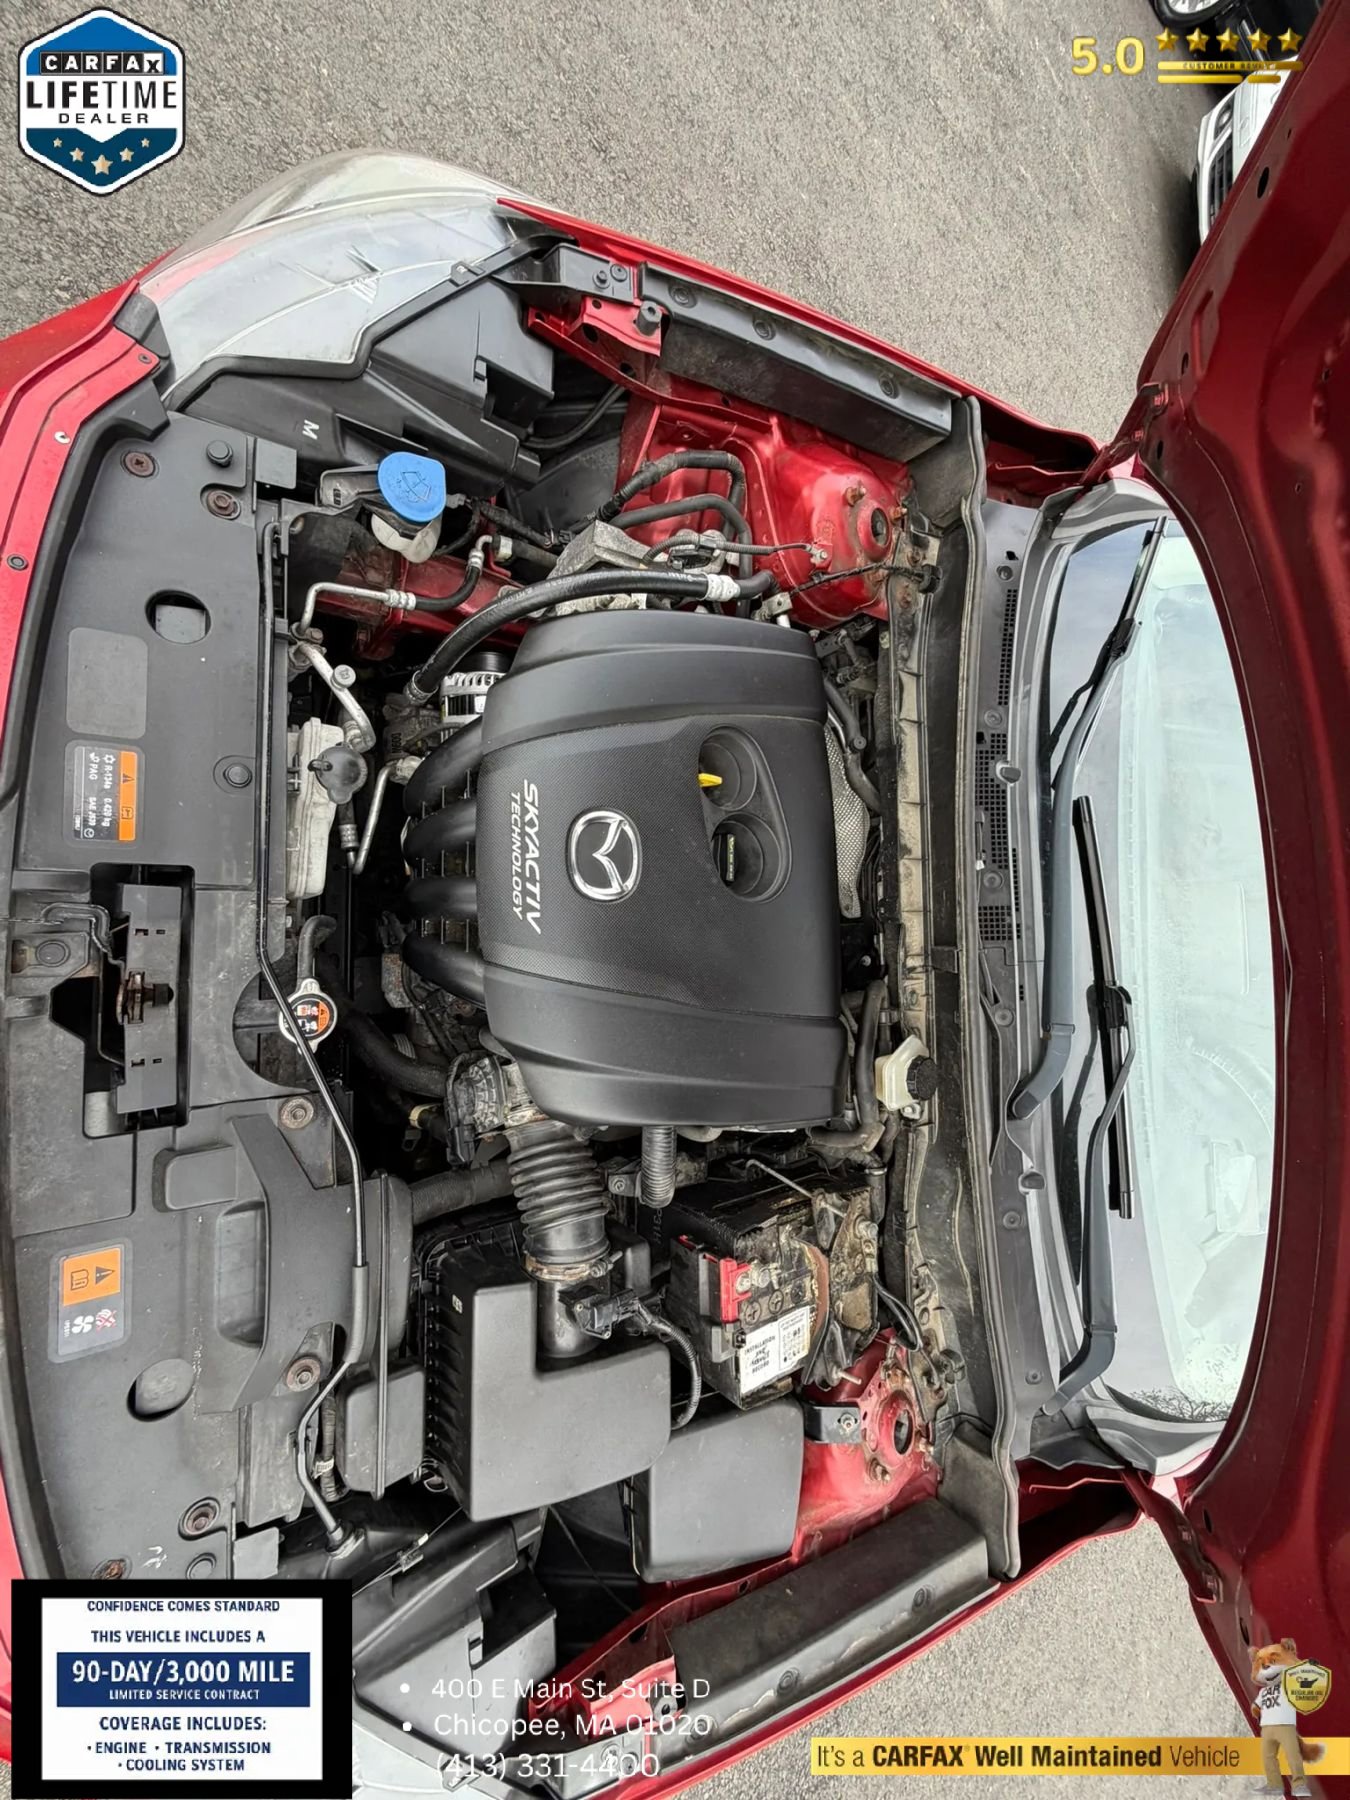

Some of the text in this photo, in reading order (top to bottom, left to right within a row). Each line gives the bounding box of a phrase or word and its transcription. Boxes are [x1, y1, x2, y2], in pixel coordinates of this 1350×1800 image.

[88, 763, 99, 780] PAG
[510, 791, 523, 921] TECHNOLOGY
[523, 778, 542, 935] SKYACTIV
